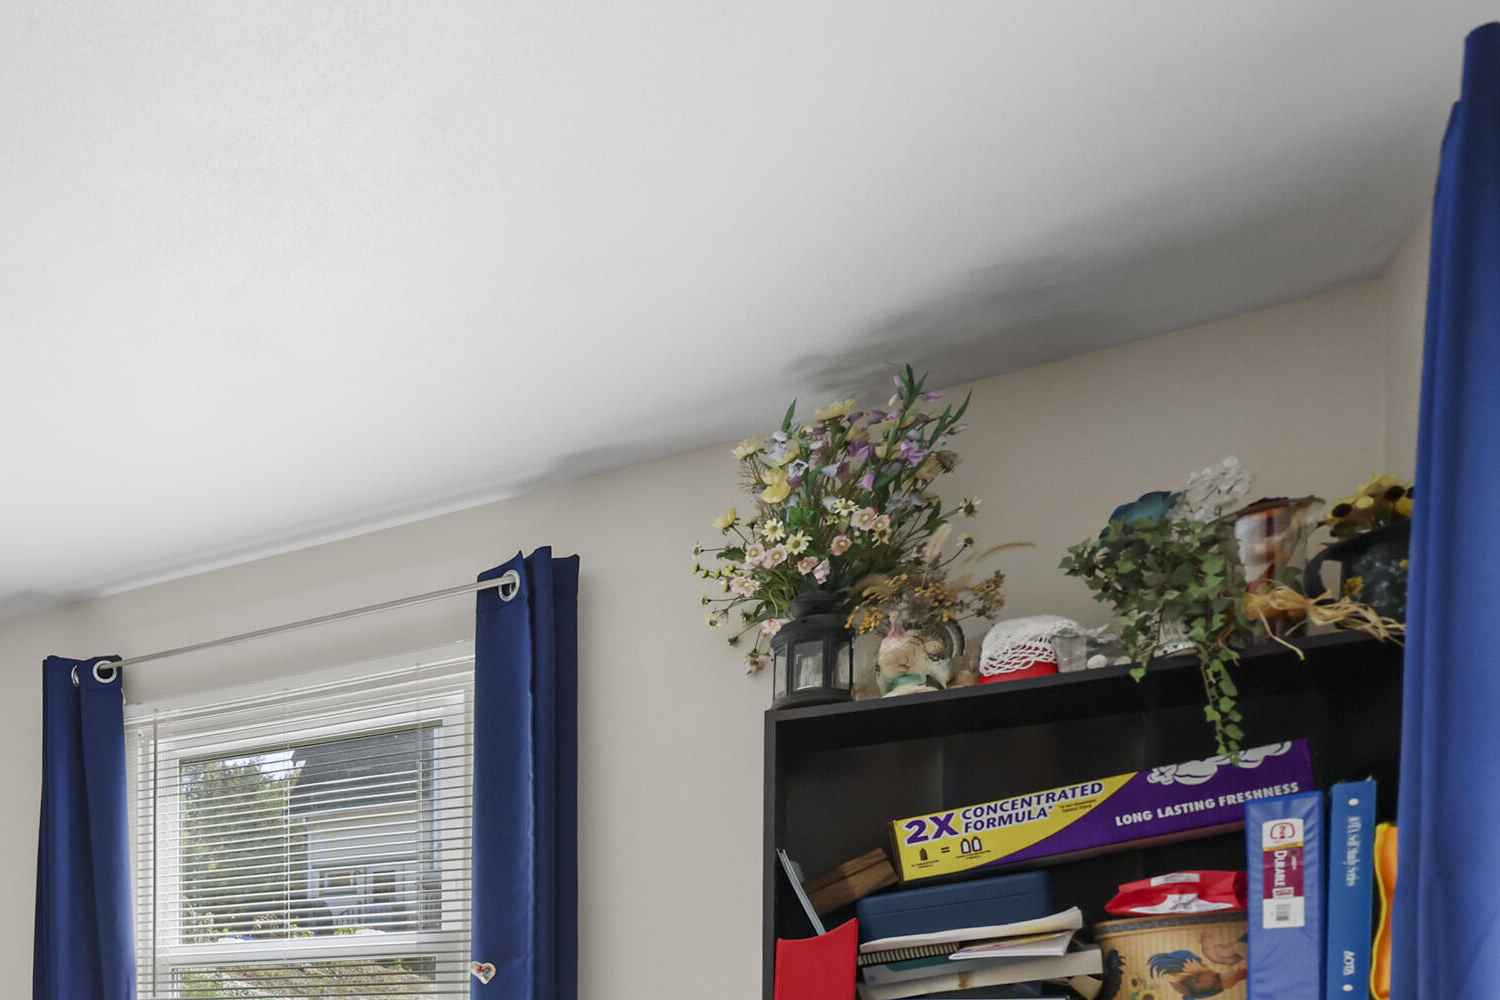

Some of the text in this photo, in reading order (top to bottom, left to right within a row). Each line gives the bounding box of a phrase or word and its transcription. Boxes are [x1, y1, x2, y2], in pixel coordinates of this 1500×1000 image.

[961, 782, 1104, 820] CONCENTRATED
[1115, 782, 1300, 826] LONG LASTING FRESHNESS
[905, 813, 958, 845] 2X
[1274, 850, 1287, 887] DURABLE
